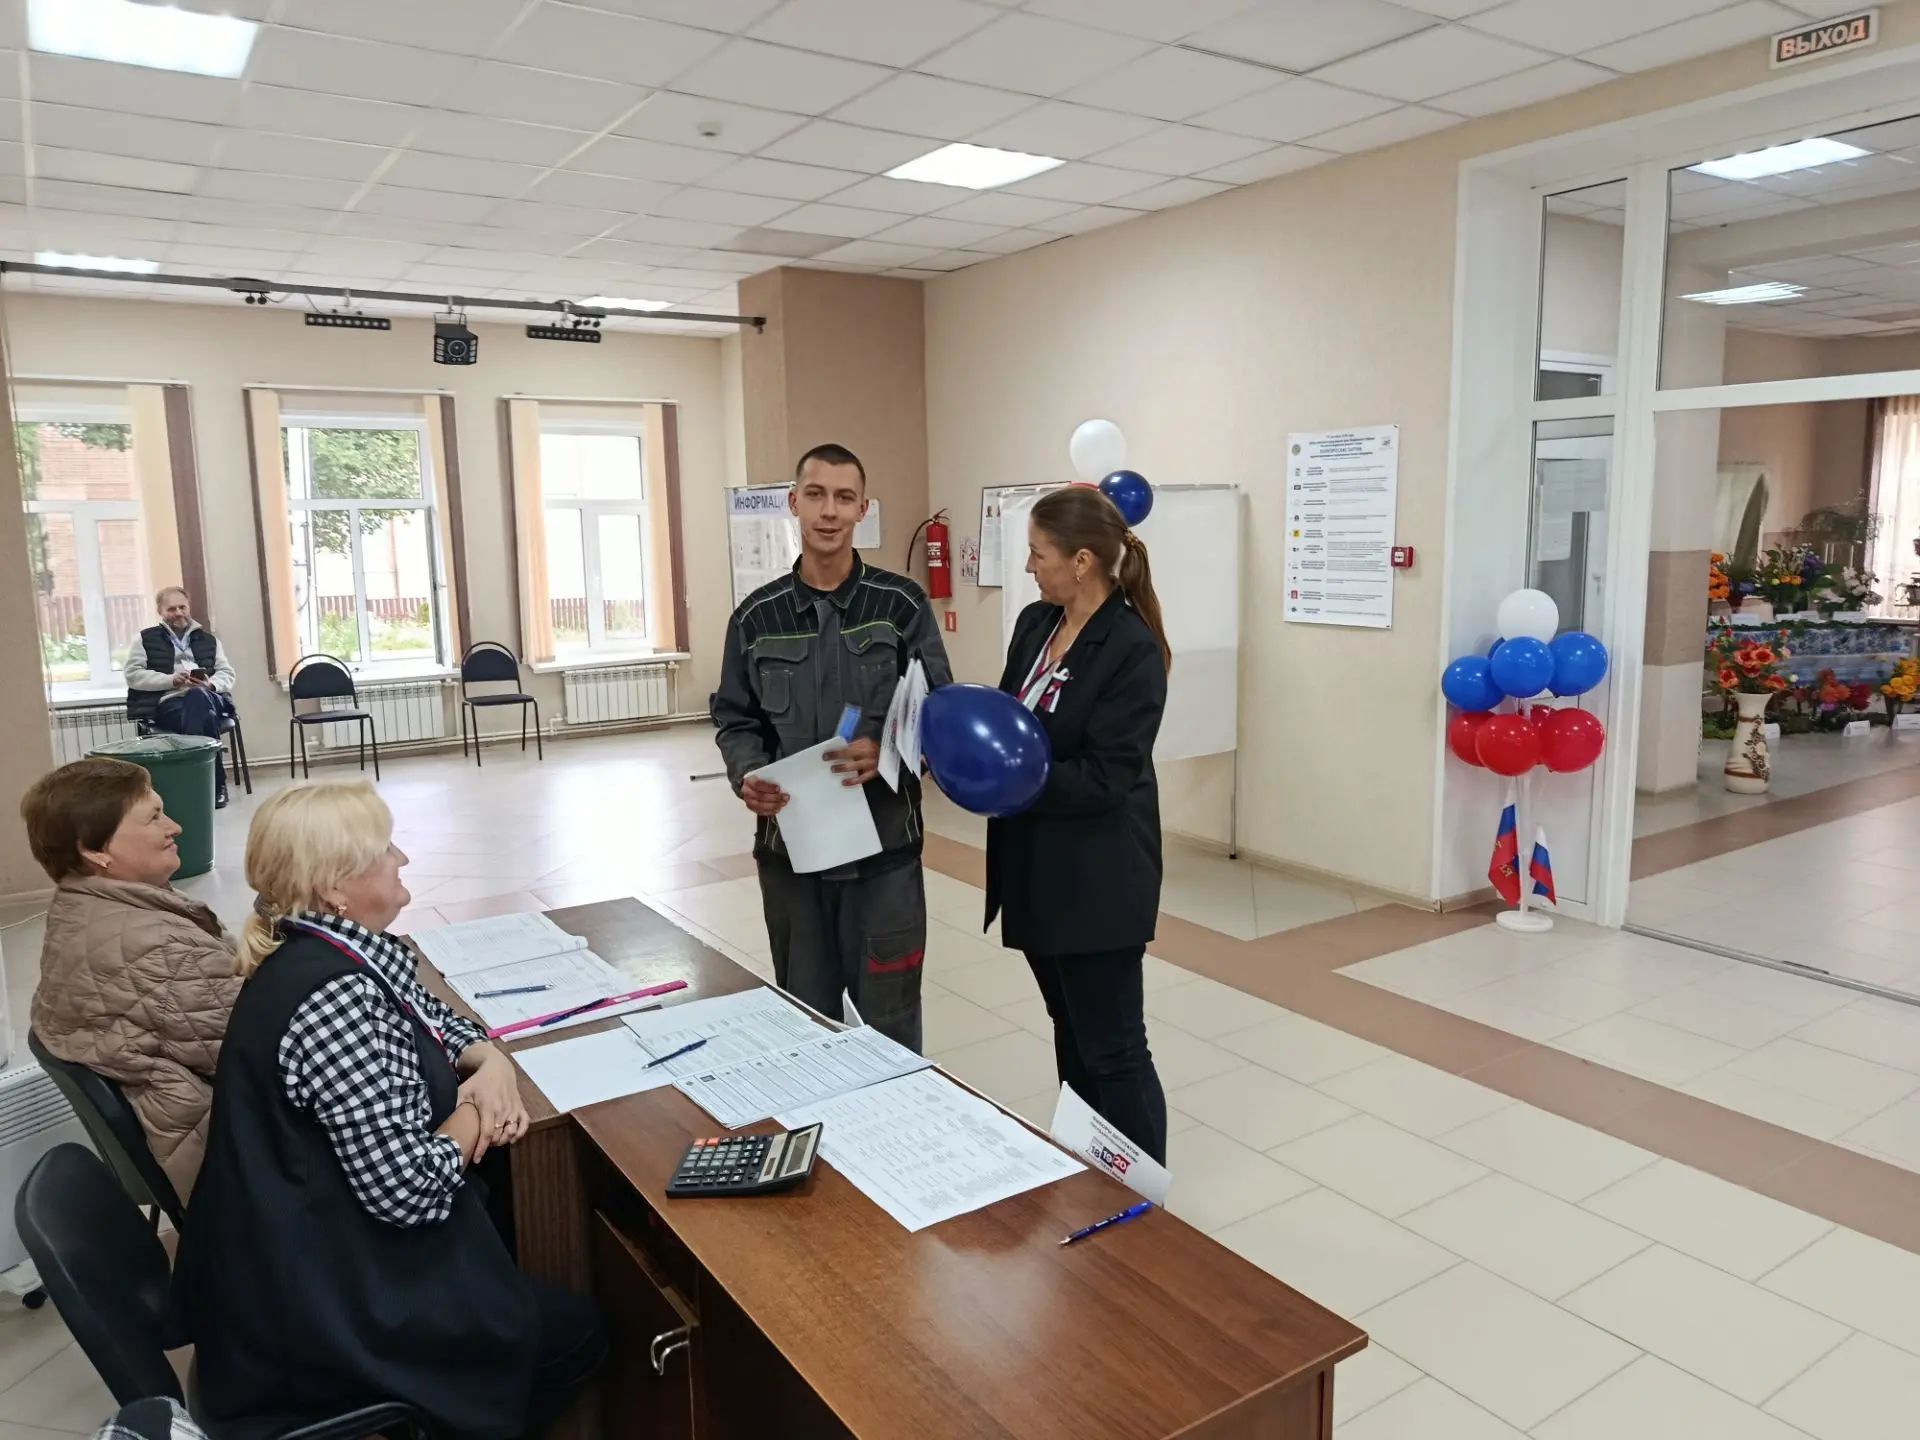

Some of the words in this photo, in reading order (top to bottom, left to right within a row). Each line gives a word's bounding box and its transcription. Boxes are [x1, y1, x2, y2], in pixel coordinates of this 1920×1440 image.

[1780, 19, 1865, 59] ВЫХОД
[1091, 1145, 1101, 1158] 18
[1114, 1155, 1127, 1171] 20
